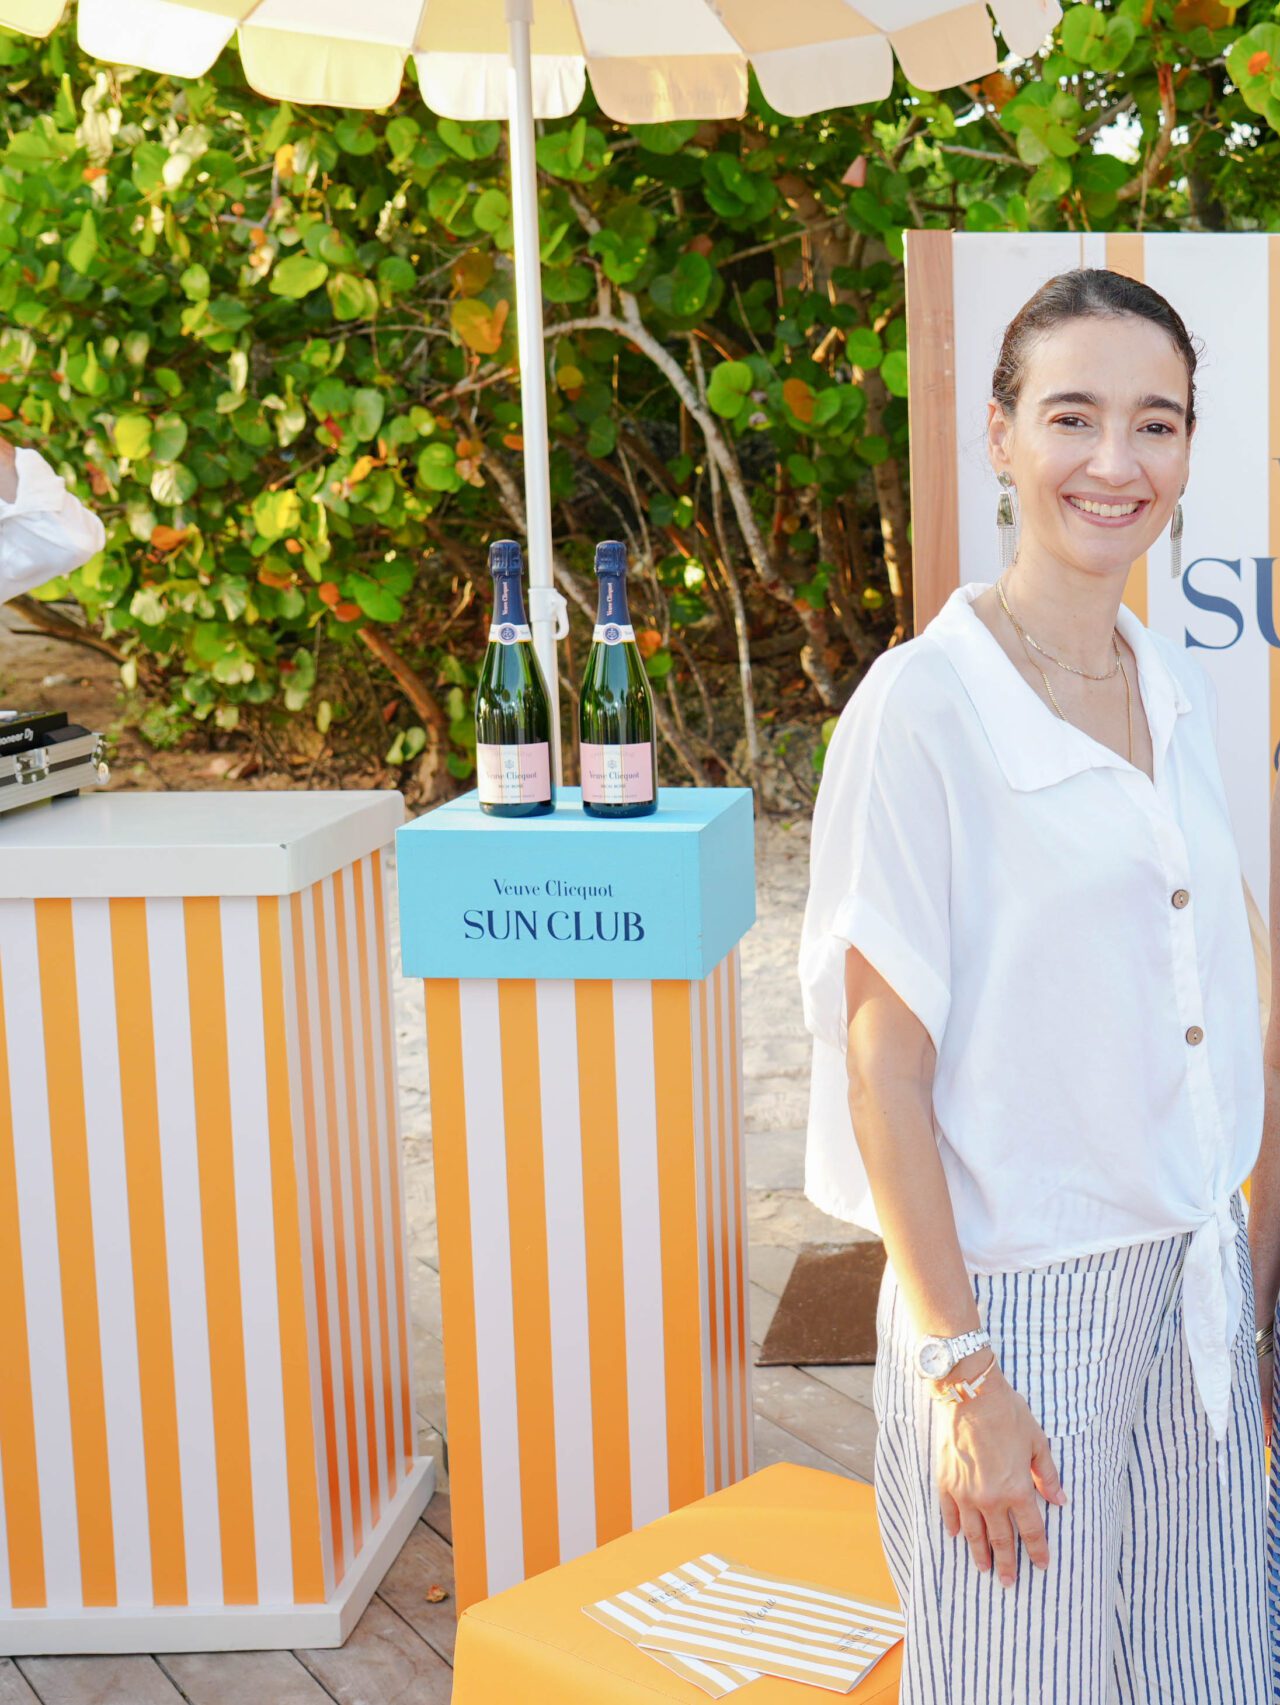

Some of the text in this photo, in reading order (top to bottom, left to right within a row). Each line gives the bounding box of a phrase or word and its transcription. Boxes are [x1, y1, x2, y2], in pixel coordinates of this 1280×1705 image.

[492, 878, 615, 901] Veuve Clicquot
[463, 909, 646, 942] SUN CLUB
